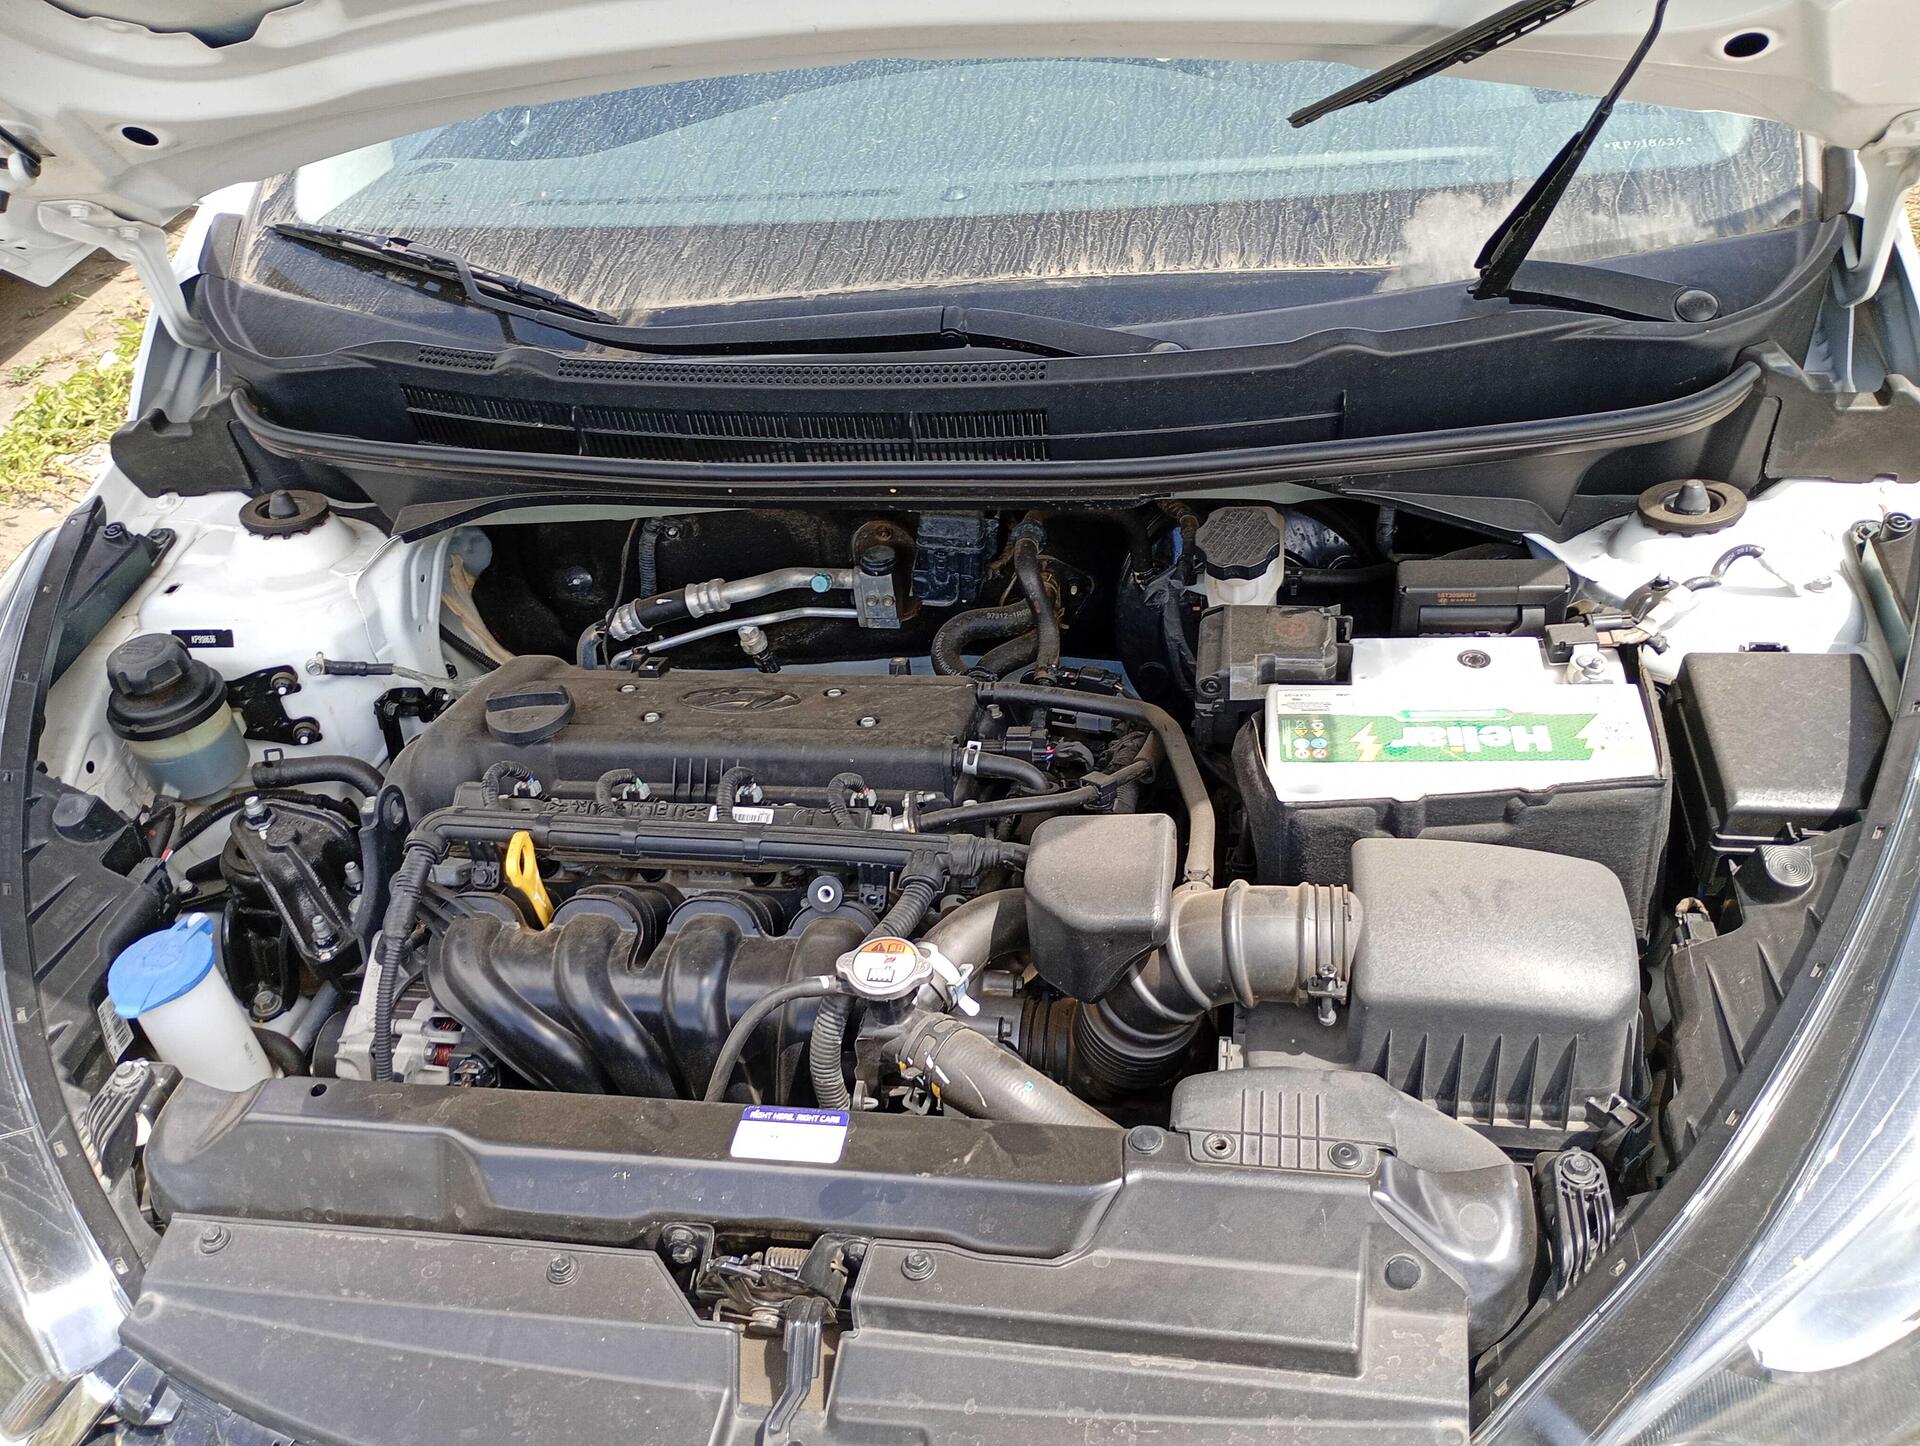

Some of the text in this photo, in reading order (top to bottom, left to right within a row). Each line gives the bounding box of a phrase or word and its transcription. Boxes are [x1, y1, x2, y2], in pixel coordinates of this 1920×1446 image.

[1391, 725, 1553, 753] Heliar
[796, 1113, 818, 1122] RIGHT
[819, 1114, 841, 1124] CARE
